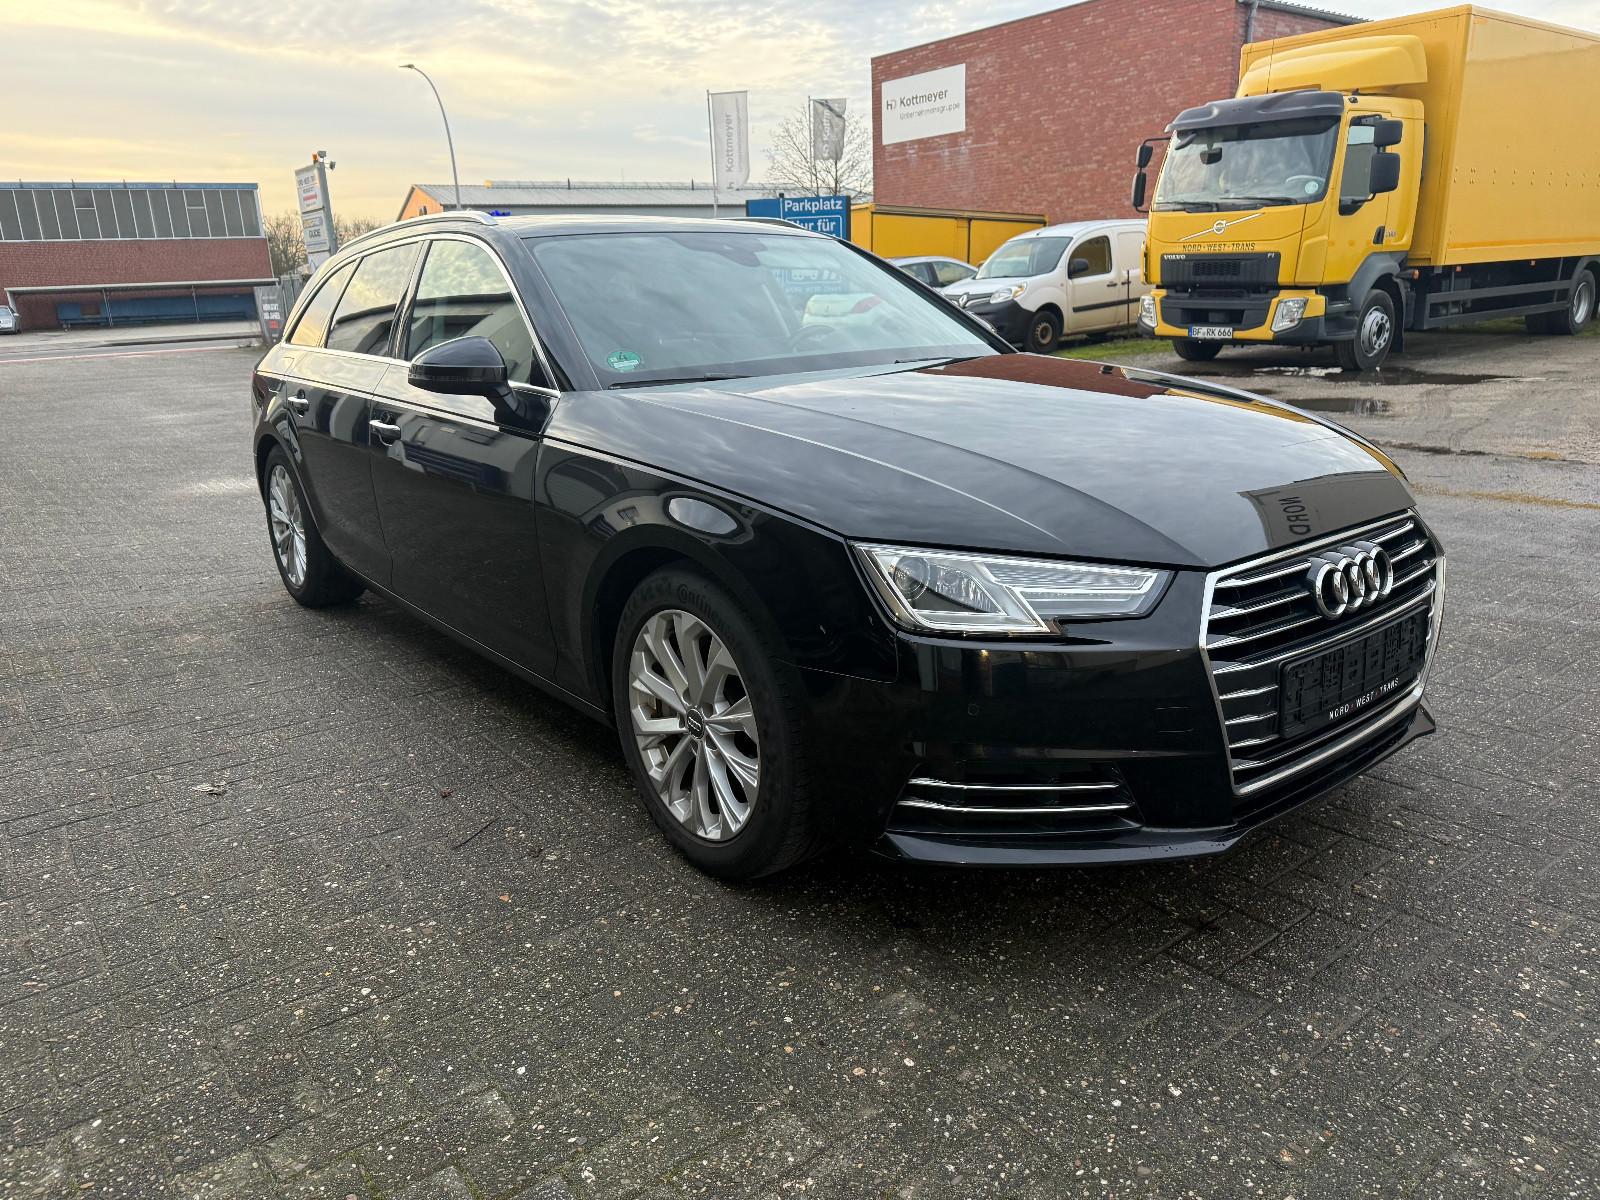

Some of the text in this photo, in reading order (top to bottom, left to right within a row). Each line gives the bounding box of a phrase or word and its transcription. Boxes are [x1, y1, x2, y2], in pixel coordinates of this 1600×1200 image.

[899, 88, 949, 108] Kottmeyer
[725, 112, 735, 173] Kottmeyer
[784, 198, 843, 213] Parkplatz
[817, 218, 836, 231] für
[1182, 242, 1256, 252] NORD WEST TRANS
[1217, 328, 1232, 337] 666
[1329, 677, 1399, 720] NORD WEST TRANS
